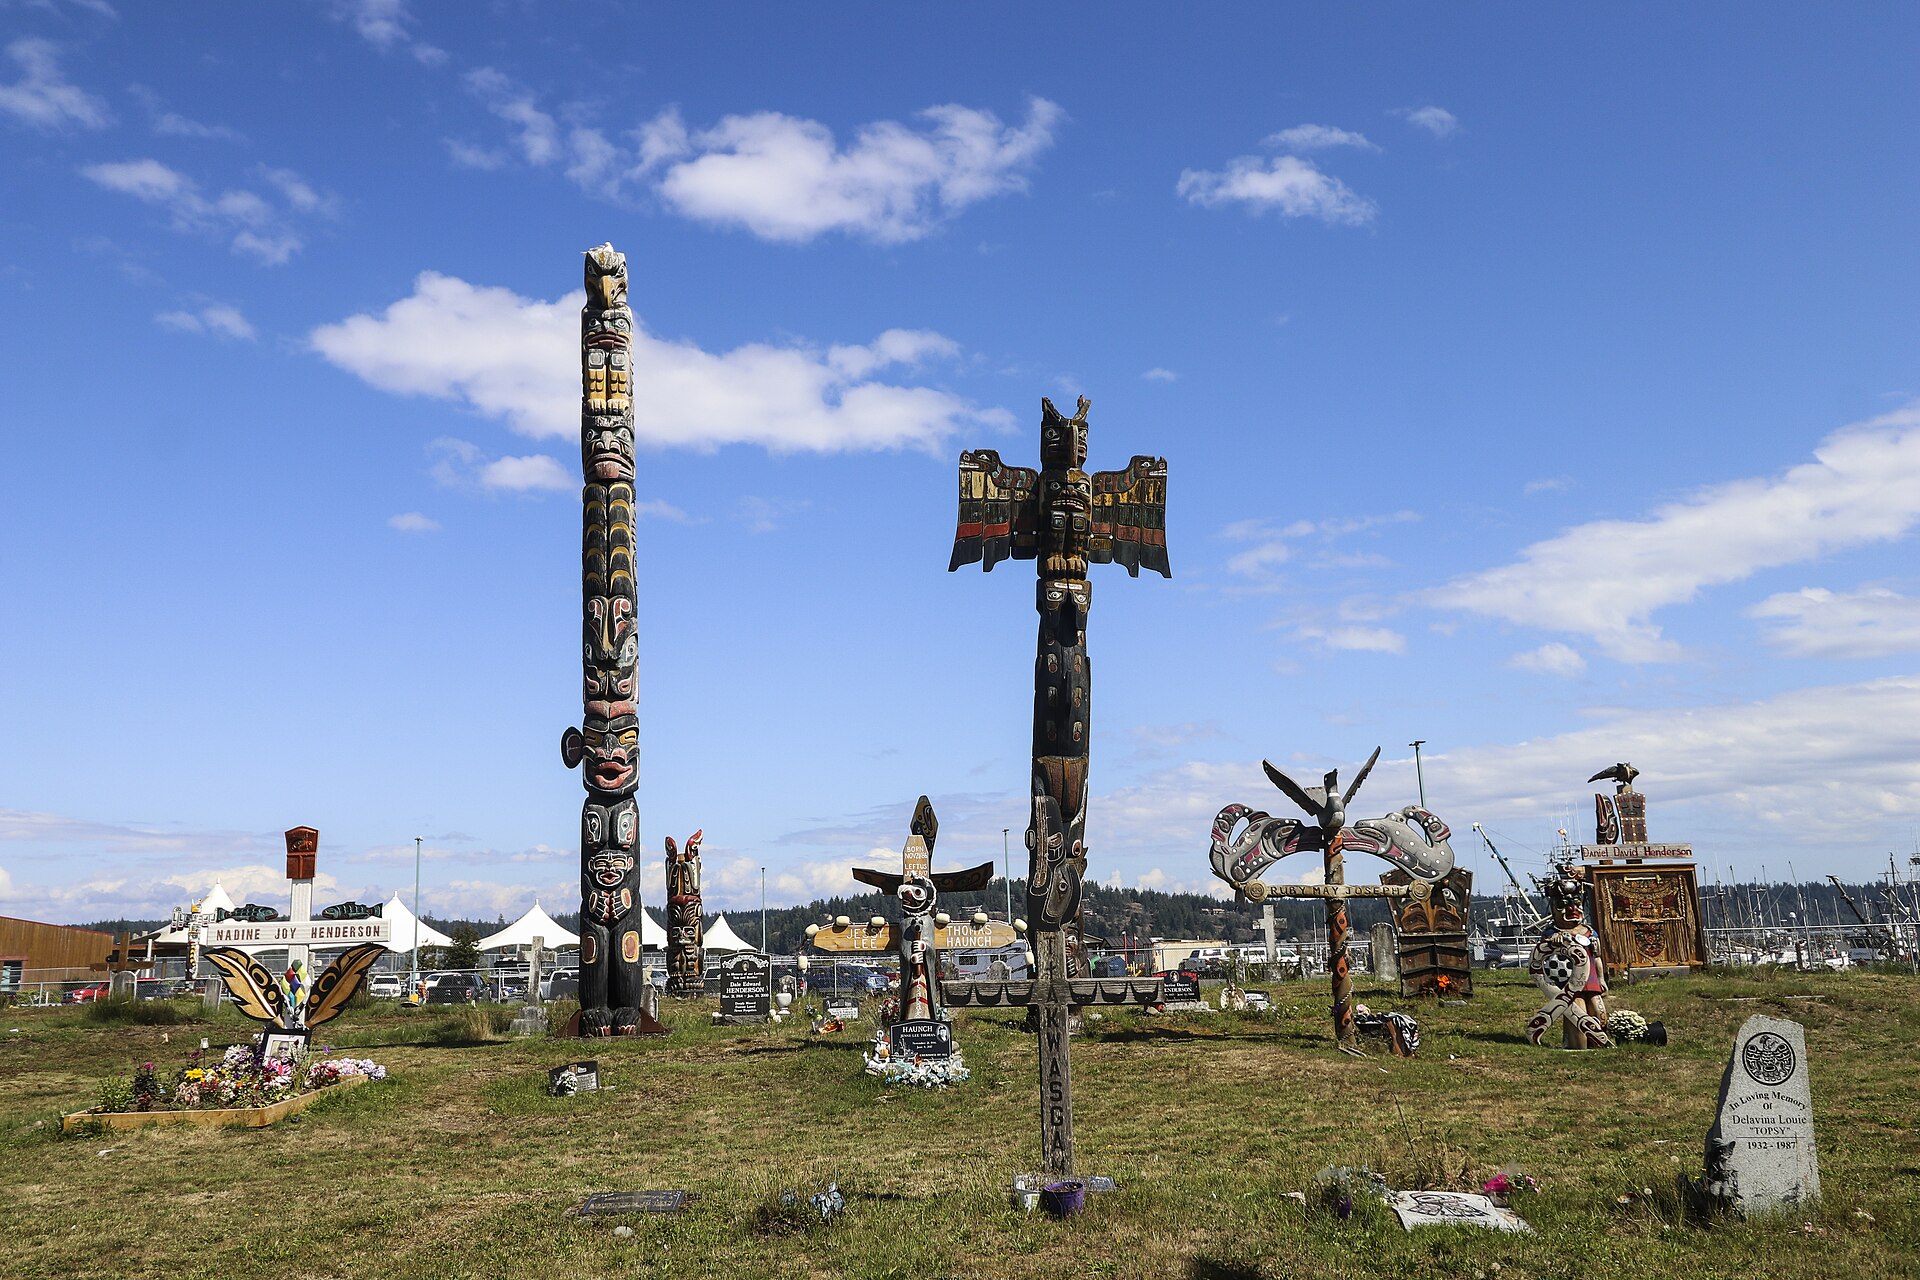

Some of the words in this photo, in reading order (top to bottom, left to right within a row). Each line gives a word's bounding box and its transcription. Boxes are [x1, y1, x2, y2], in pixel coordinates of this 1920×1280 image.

[1582, 847, 1609, 857] Daniel
[1613, 846, 1639, 857] David
[1643, 846, 1693, 857] Henderson
[1270, 885, 1306, 895] RUBY
[1312, 885, 1339, 895] MAY
[1344, 885, 1400, 895] JOSEPH
[216, 928, 261, 941] NADINE
[274, 927, 297, 940] JOY
[310, 925, 381, 939] HENDERSON
[946, 924, 993, 936] THOMAS
[853, 938, 877, 949] LEE
[946, 936, 992, 947] HAUNCH
[902, 1025, 933, 1033] HAUNCH
[1728, 1101, 1740, 1110] In
[1739, 1091, 1770, 1105] Loving
[1771, 1090, 1807, 1111] Memory
[1732, 1114, 1776, 1125] Delavina
[1778, 1114, 1807, 1125] Louie
[1749, 1126, 1791, 1135] "TOPSY"
[1747, 1141, 1768, 1150] 1932
[1776, 1141, 1796, 1150] 1987
